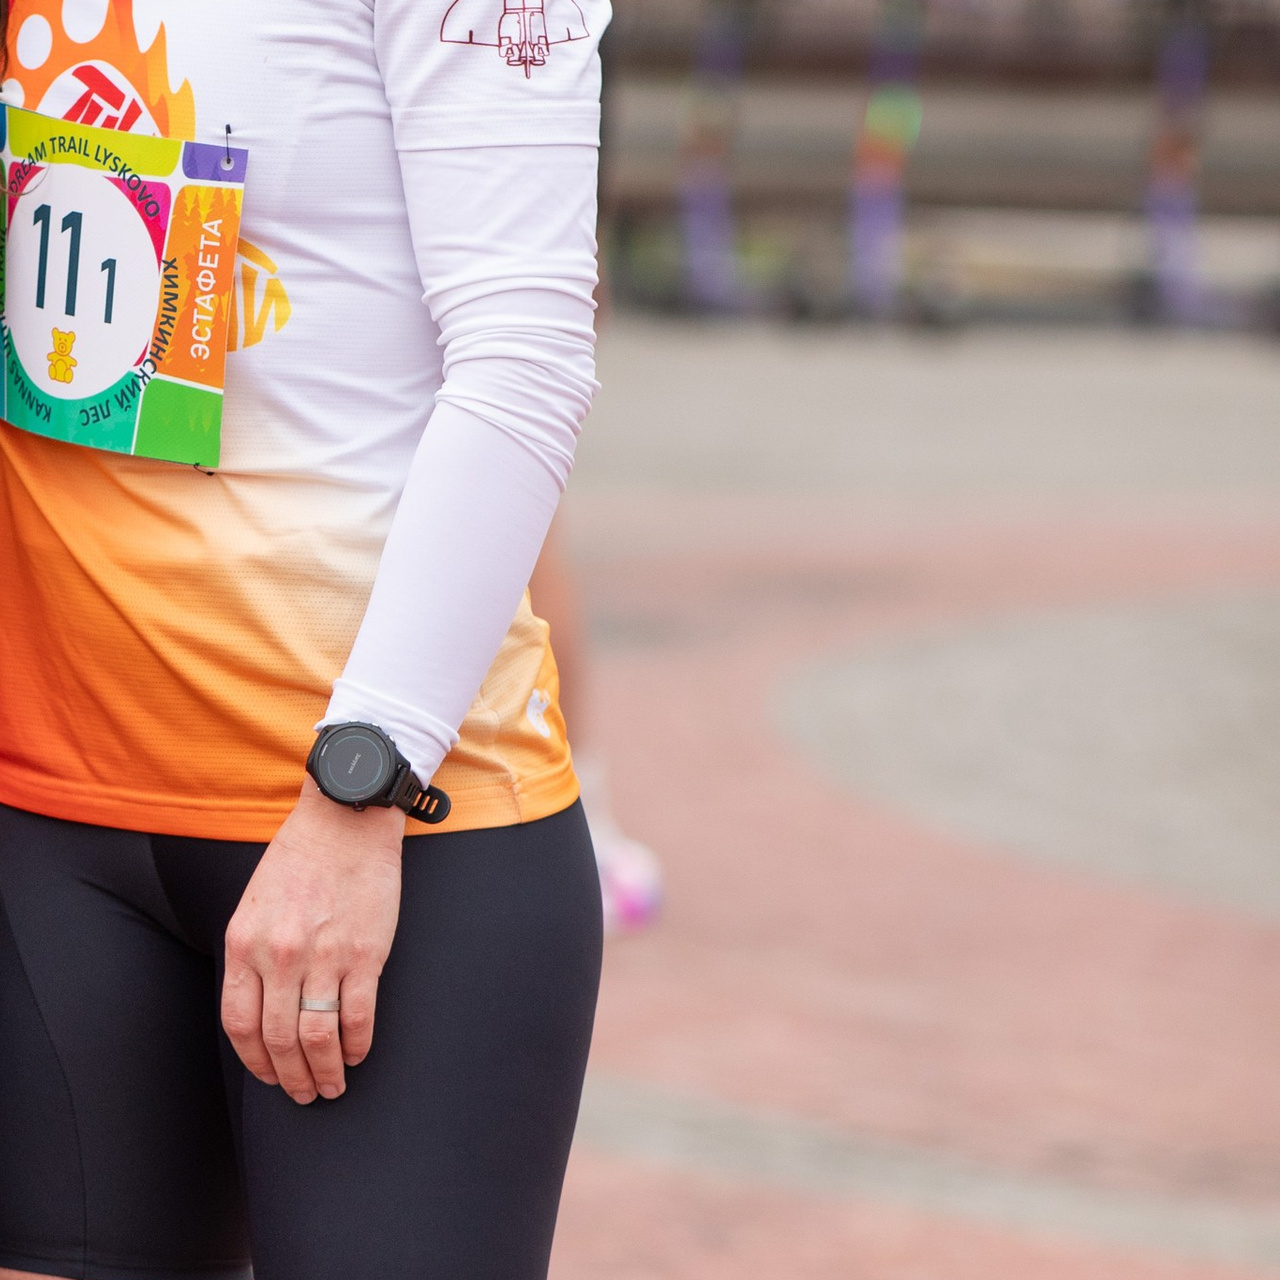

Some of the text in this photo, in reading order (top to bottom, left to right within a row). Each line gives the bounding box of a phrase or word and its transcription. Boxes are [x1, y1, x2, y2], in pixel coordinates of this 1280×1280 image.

[9, 135, 161, 218] DREAM TRAIL LYSKOVO
[32, 203, 83, 318] 11
[100, 257, 117, 324] 1
[190, 218, 223, 361] ЭСТАФЕТА
[9, 360, 52, 423] KANNAS
[79, 257, 179, 427] ХИМКИНСКИЙ ЛЕС
